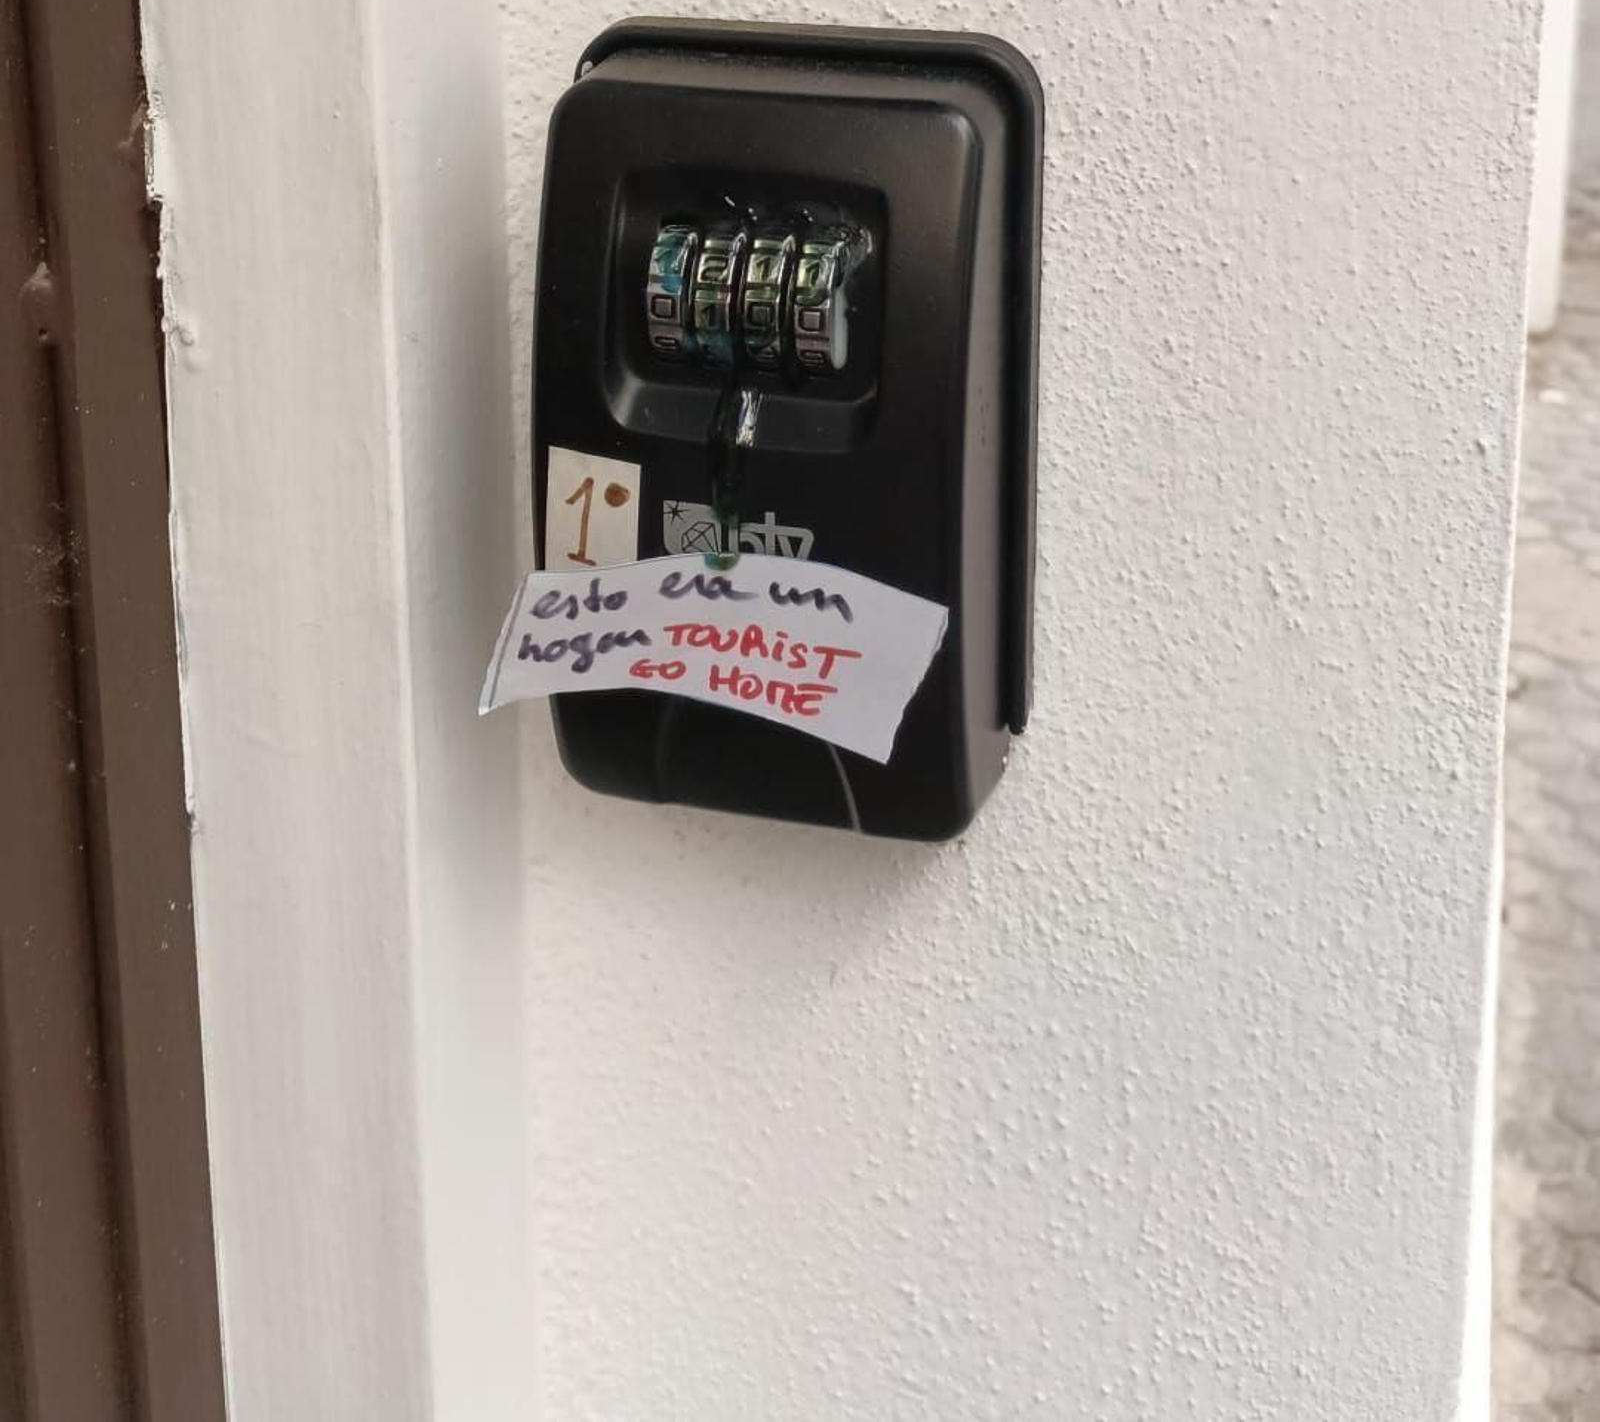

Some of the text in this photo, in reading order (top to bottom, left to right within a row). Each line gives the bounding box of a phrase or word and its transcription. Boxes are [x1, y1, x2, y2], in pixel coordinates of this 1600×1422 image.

[530, 570, 854, 623] esto era un
[629, 659, 839, 716] GO HOME
